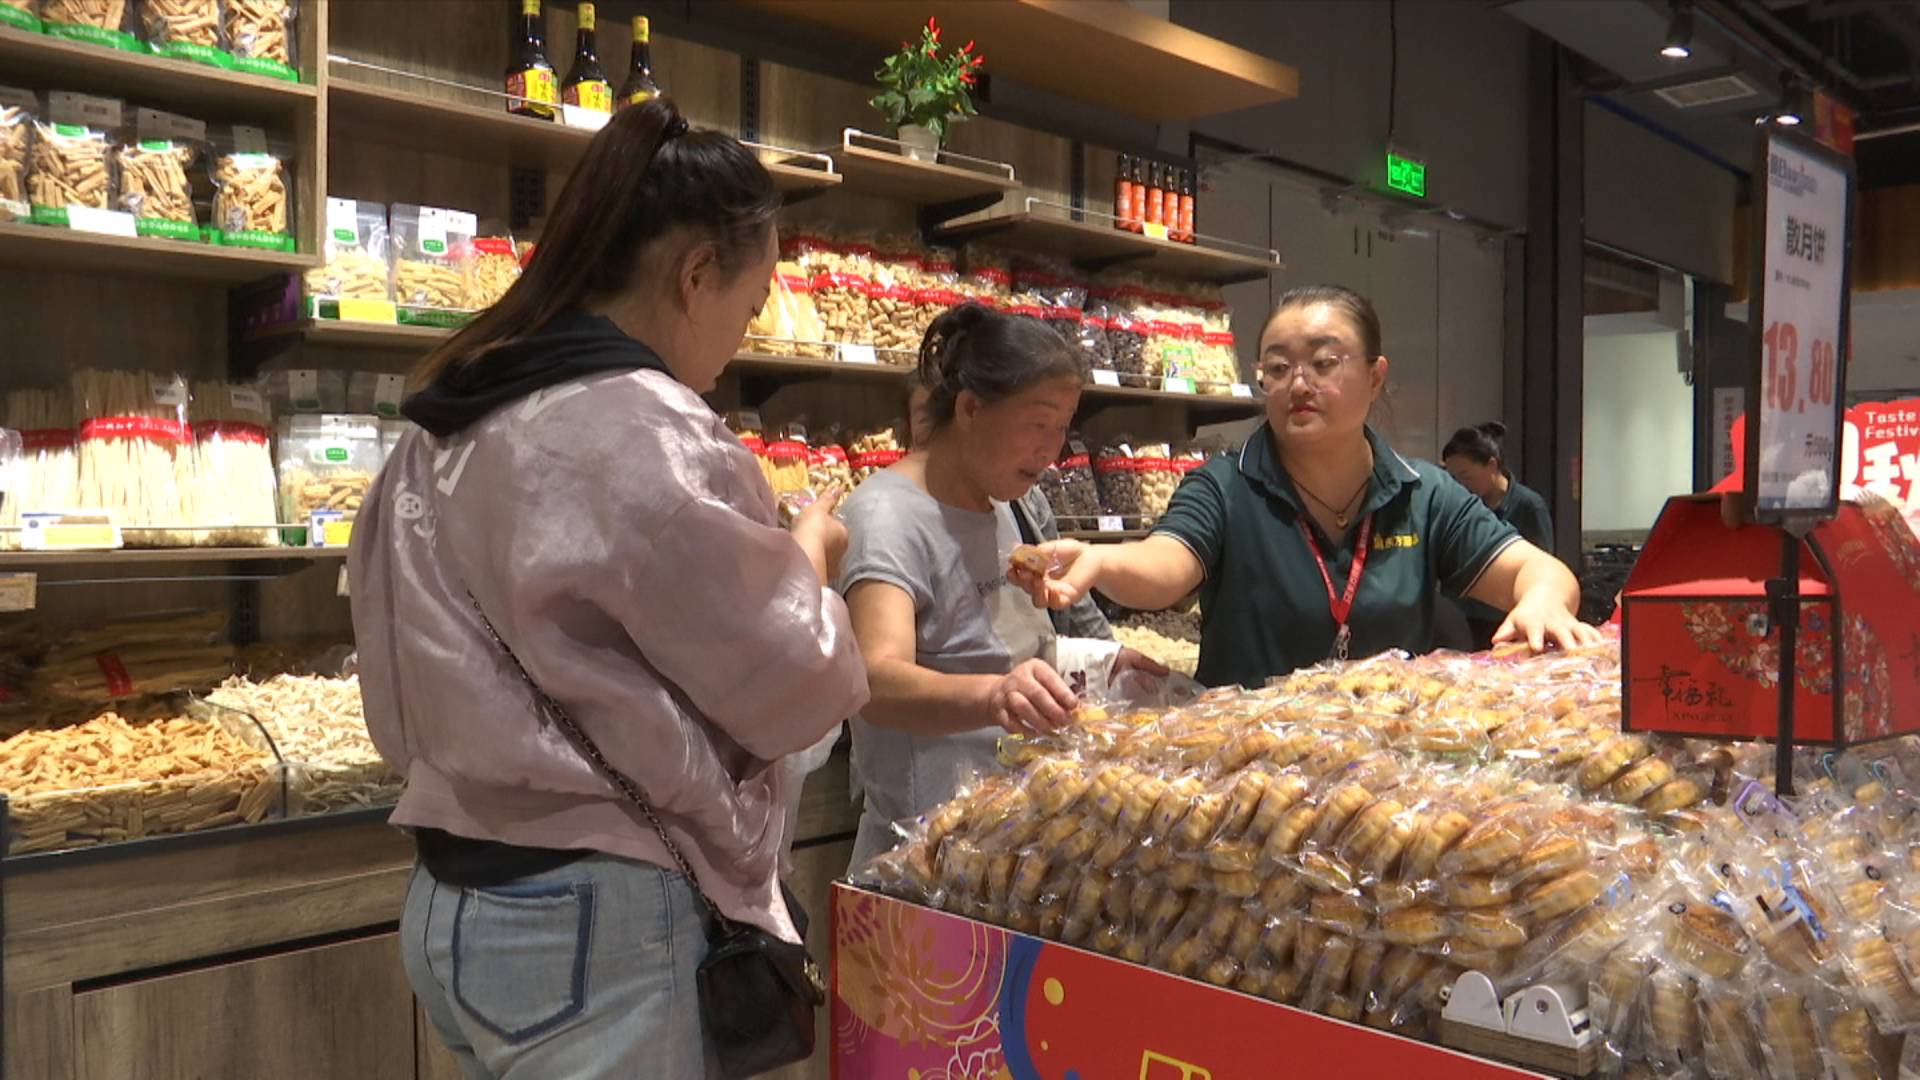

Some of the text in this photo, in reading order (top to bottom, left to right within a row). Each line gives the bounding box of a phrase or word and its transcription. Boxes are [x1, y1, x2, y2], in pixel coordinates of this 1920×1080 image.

[1785, 214, 1826, 263] 散月饼
[1764, 321, 1833, 414] 13.80
[1866, 409, 1917, 424] Taste
